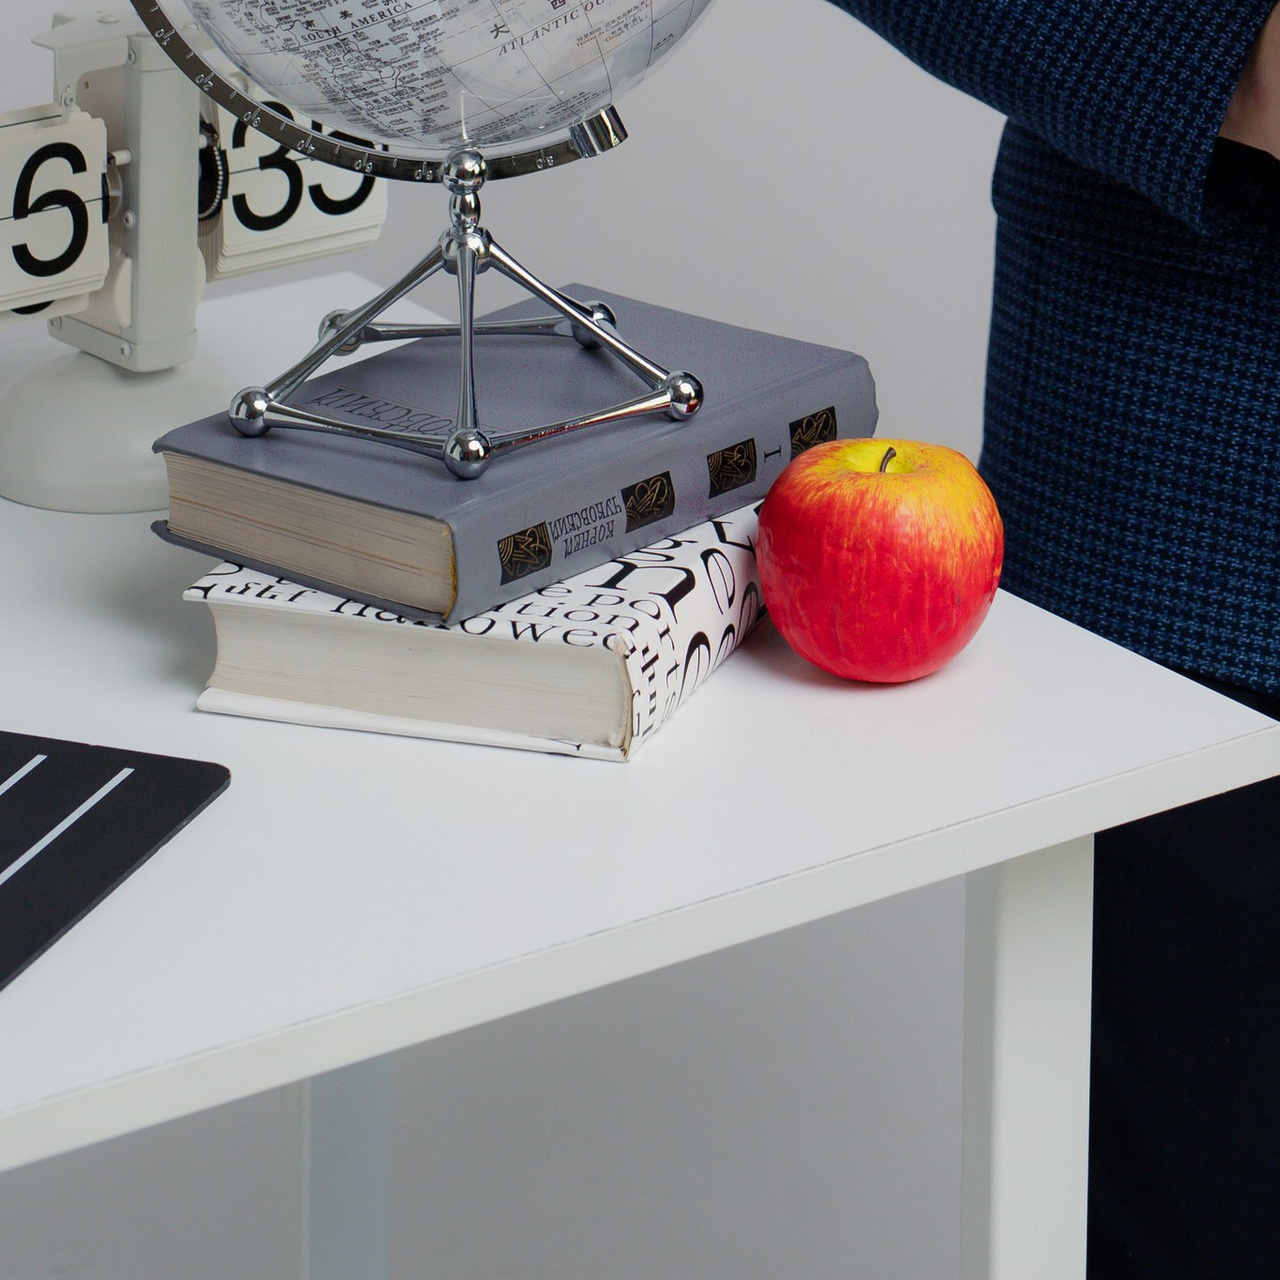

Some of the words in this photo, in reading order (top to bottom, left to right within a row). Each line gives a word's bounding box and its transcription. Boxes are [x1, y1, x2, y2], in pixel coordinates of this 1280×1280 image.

[301, 27, 342, 43] SOUTH
[350, 1, 413, 30] AMERICA
[498, 8, 580, 57] ATLANTIC
[12, 141, 89, 278] 6
[548, 496, 623, 543] ЧУКОВСКИЙ
[564, 520, 615, 559] КОРНЕЙ
